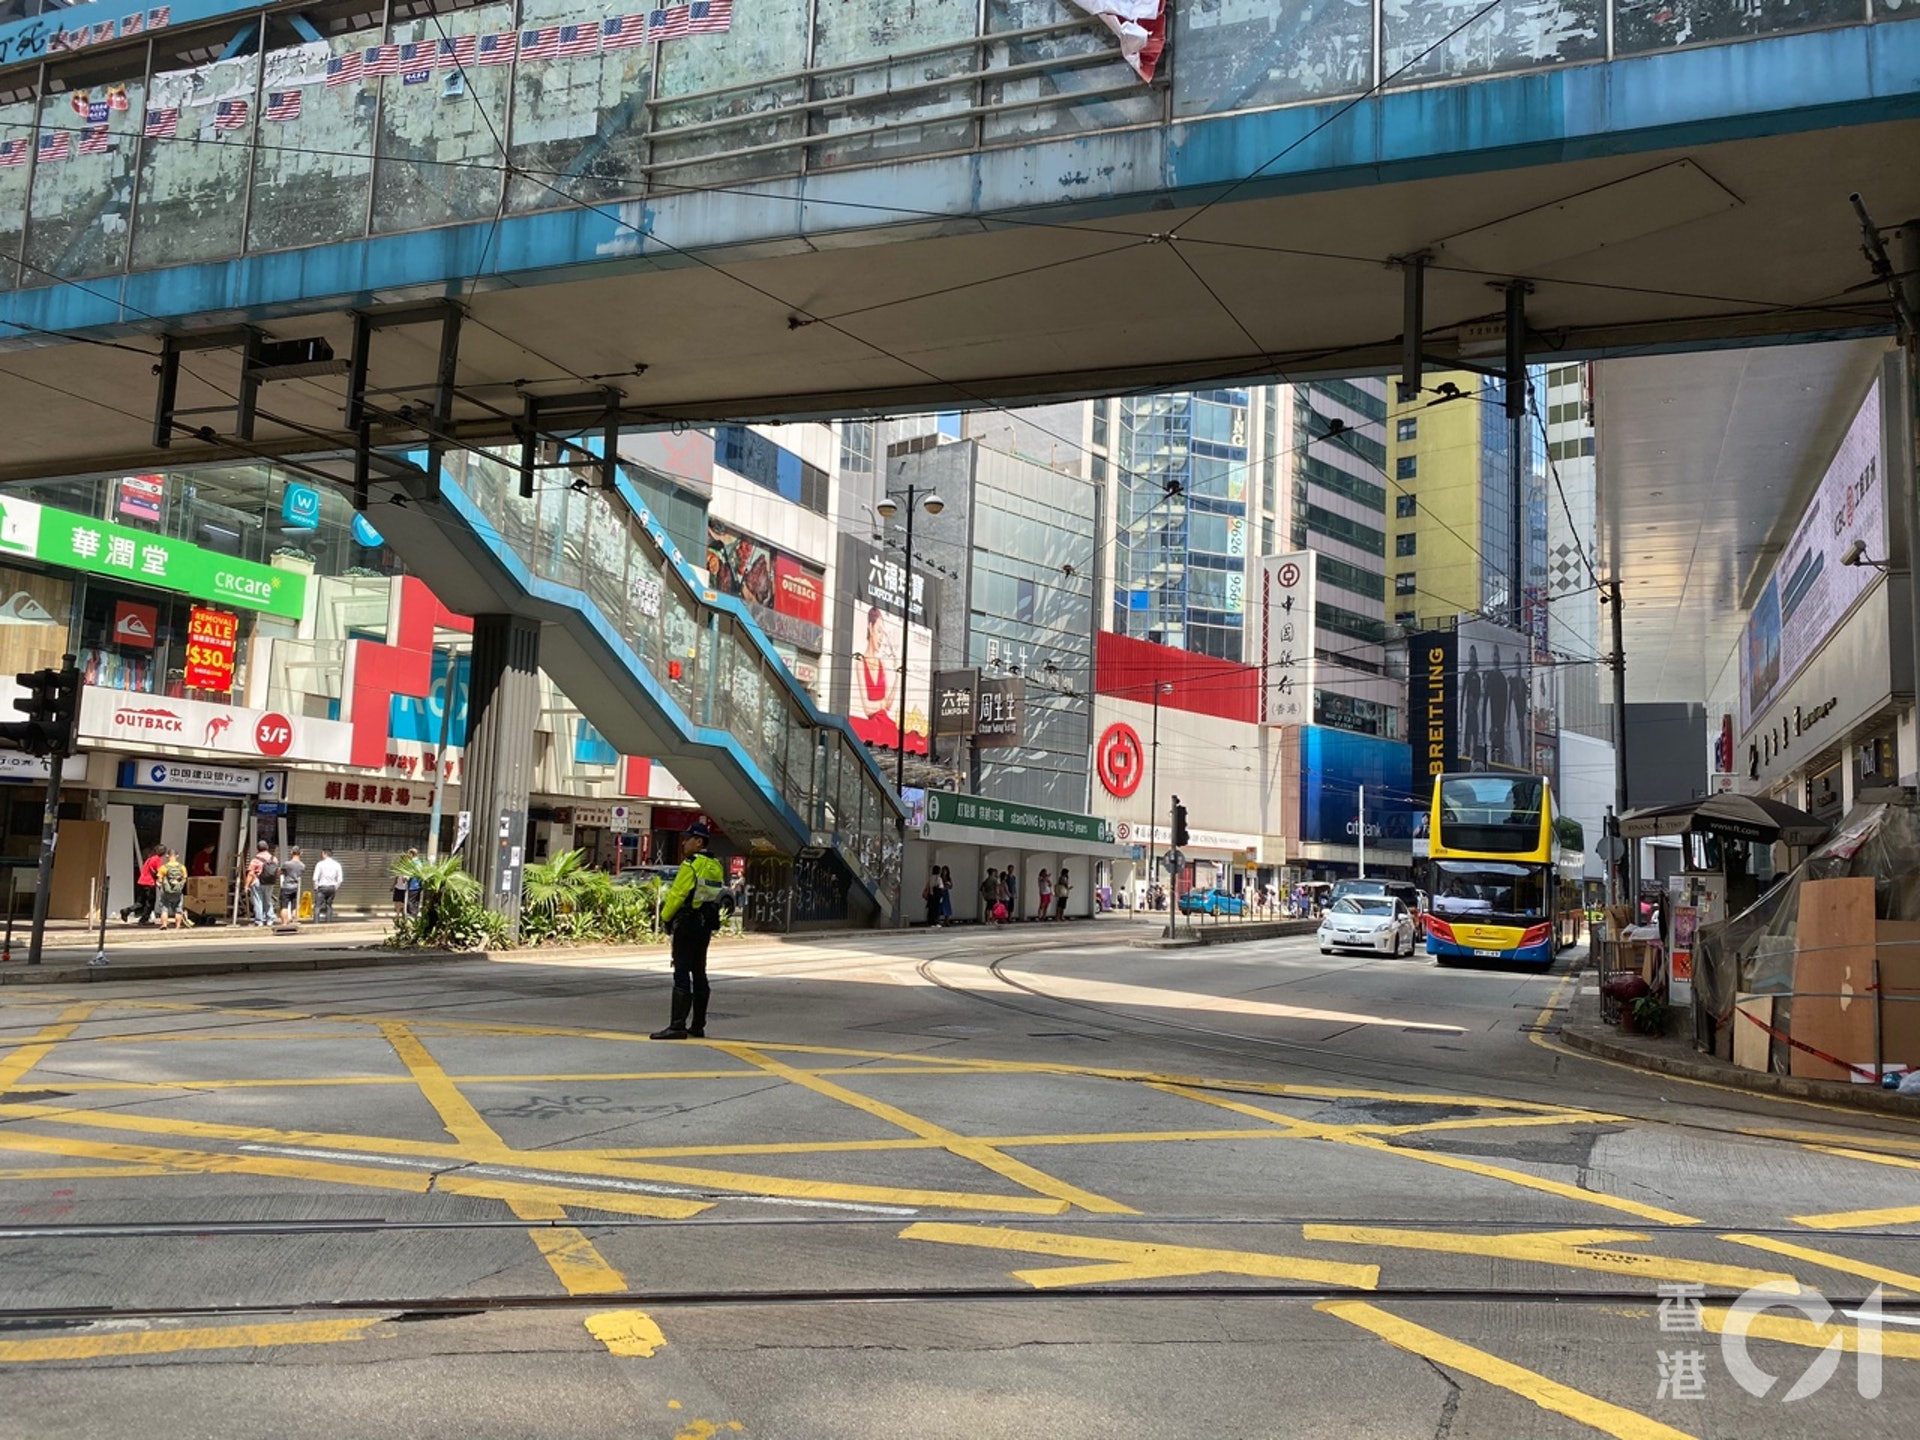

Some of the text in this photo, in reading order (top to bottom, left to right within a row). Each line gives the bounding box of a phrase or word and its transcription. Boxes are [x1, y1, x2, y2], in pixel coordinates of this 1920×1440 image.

[71, 526, 169, 577] 華潤堂
[782, 577, 816, 600] OUTBACK
[193, 620, 232, 640] SALE
[195, 612, 232, 627] REMOVAL
[190, 645, 223, 668] $30
[980, 692, 1016, 721] 周生生
[1429, 647, 1444, 776] BREITLING
[114, 712, 183, 732] OUTBACK
[259, 725, 288, 744] 3/F
[423, 752, 454, 780] By
[1039, 817, 1046, 829] by
[1046, 820, 1057, 831] you
[1058, 818, 1066, 831] for
[1066, 820, 1074, 833] 115
[744, 884, 788, 906] Free
[755, 905, 782, 925] HK
